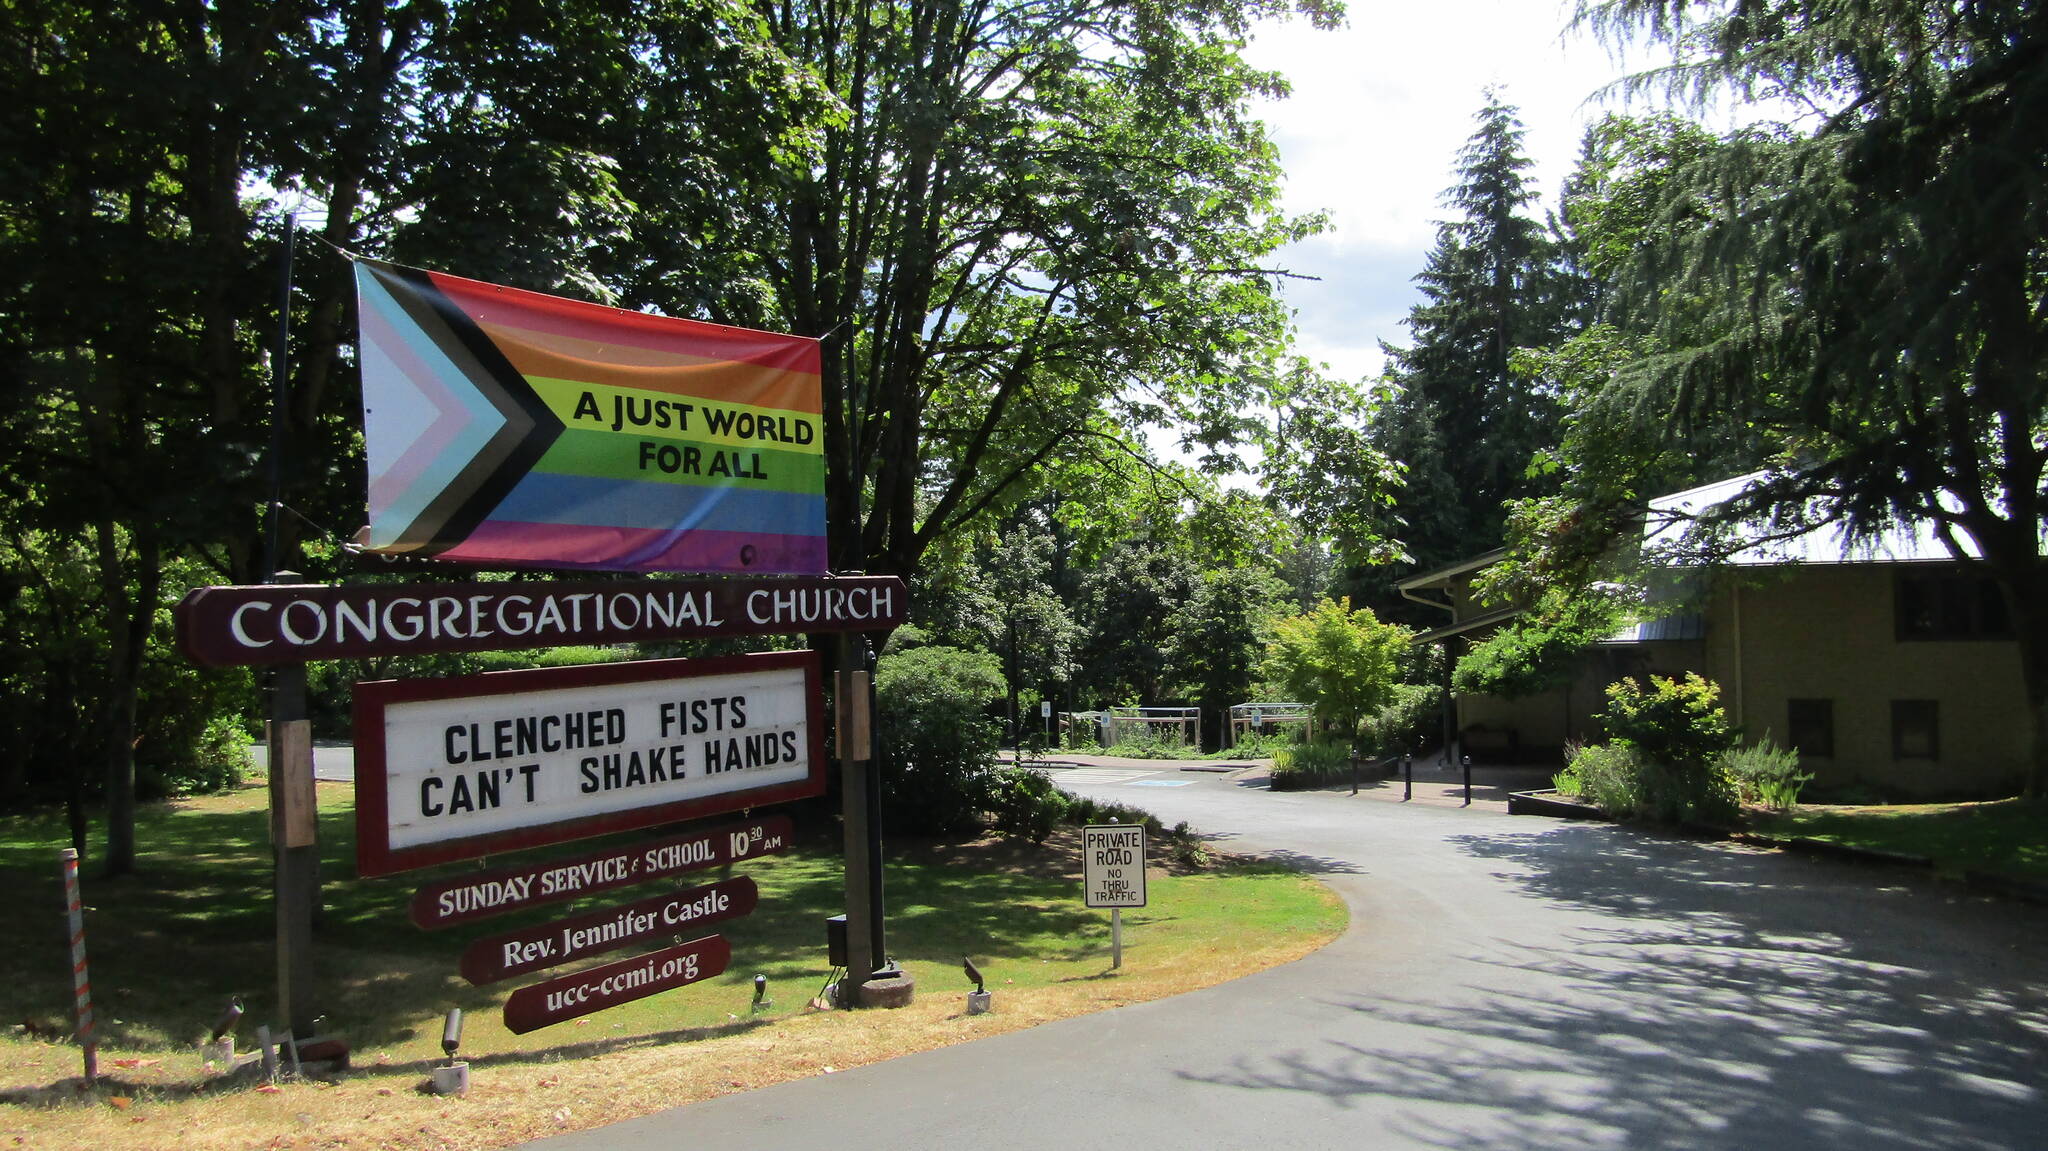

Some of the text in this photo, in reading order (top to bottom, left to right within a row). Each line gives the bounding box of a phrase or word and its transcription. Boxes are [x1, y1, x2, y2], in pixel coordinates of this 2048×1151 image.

[573, 391, 814, 445] A JUST WORLD
[639, 442, 768, 480] FOR ALL
[231, 587, 893, 647] CONGREGATIONAL CHURCH
[445, 696, 746, 764] CLENCHED FISTS
[420, 730, 796, 817] CAN'T SHAKE HANDS
[1087, 832, 1140, 848] PRIVATE
[1096, 850, 1133, 866] ROAD
[439, 874, 536, 917] SUNDAY
[541, 856, 628, 895] SERVICE
[631, 857, 640, 873] &
[646, 838, 715, 873] SCHOOL
[763, 835, 781, 850] AM
[1094, 891, 1137, 902] TRAFFIC
[1101, 880, 1129, 890] THRU
[1107, 869, 1122, 879] NO
[503, 890, 729, 968] Rev. Jennifer Castle
[546, 952, 699, 1011] ucc-ccmi.org
